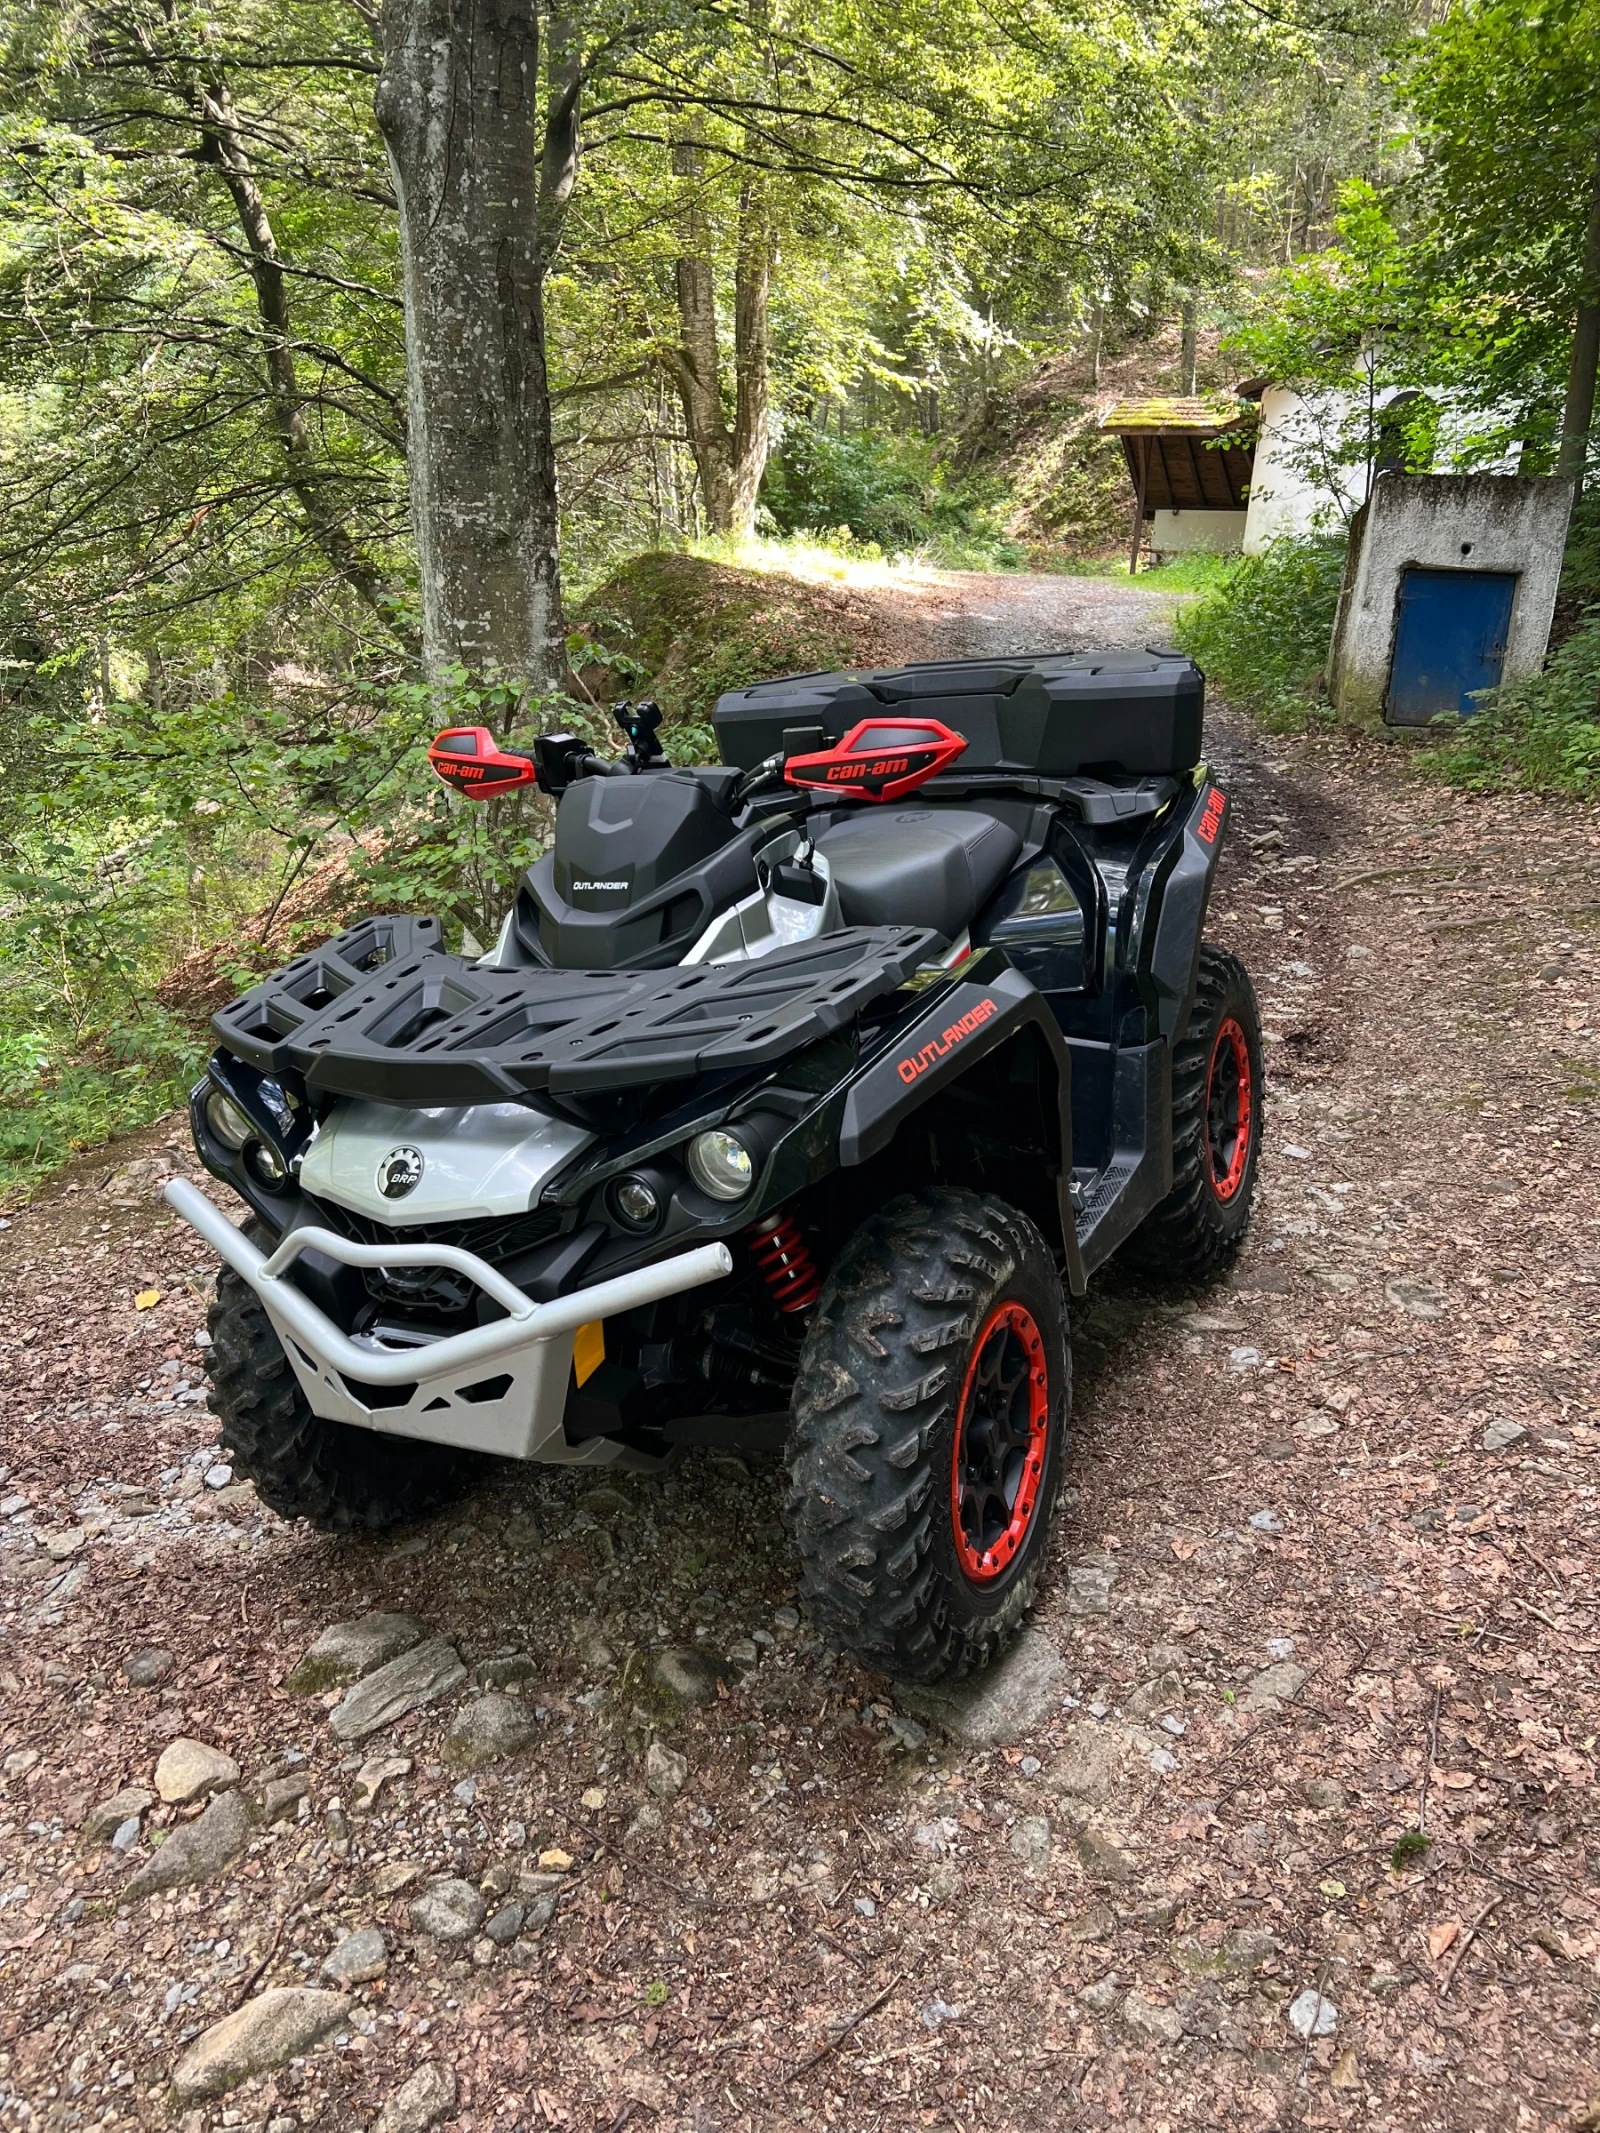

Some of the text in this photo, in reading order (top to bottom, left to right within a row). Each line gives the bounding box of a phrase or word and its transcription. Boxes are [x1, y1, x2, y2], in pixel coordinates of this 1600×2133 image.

[437, 761, 485, 780] can-am
[826, 758, 909, 781] can-am
[1197, 787, 1227, 844] can-am
[572, 881, 629, 891] OUTLANDER
[897, 998, 999, 1084] OUTLANDER
[390, 1173, 418, 1184] BRP
